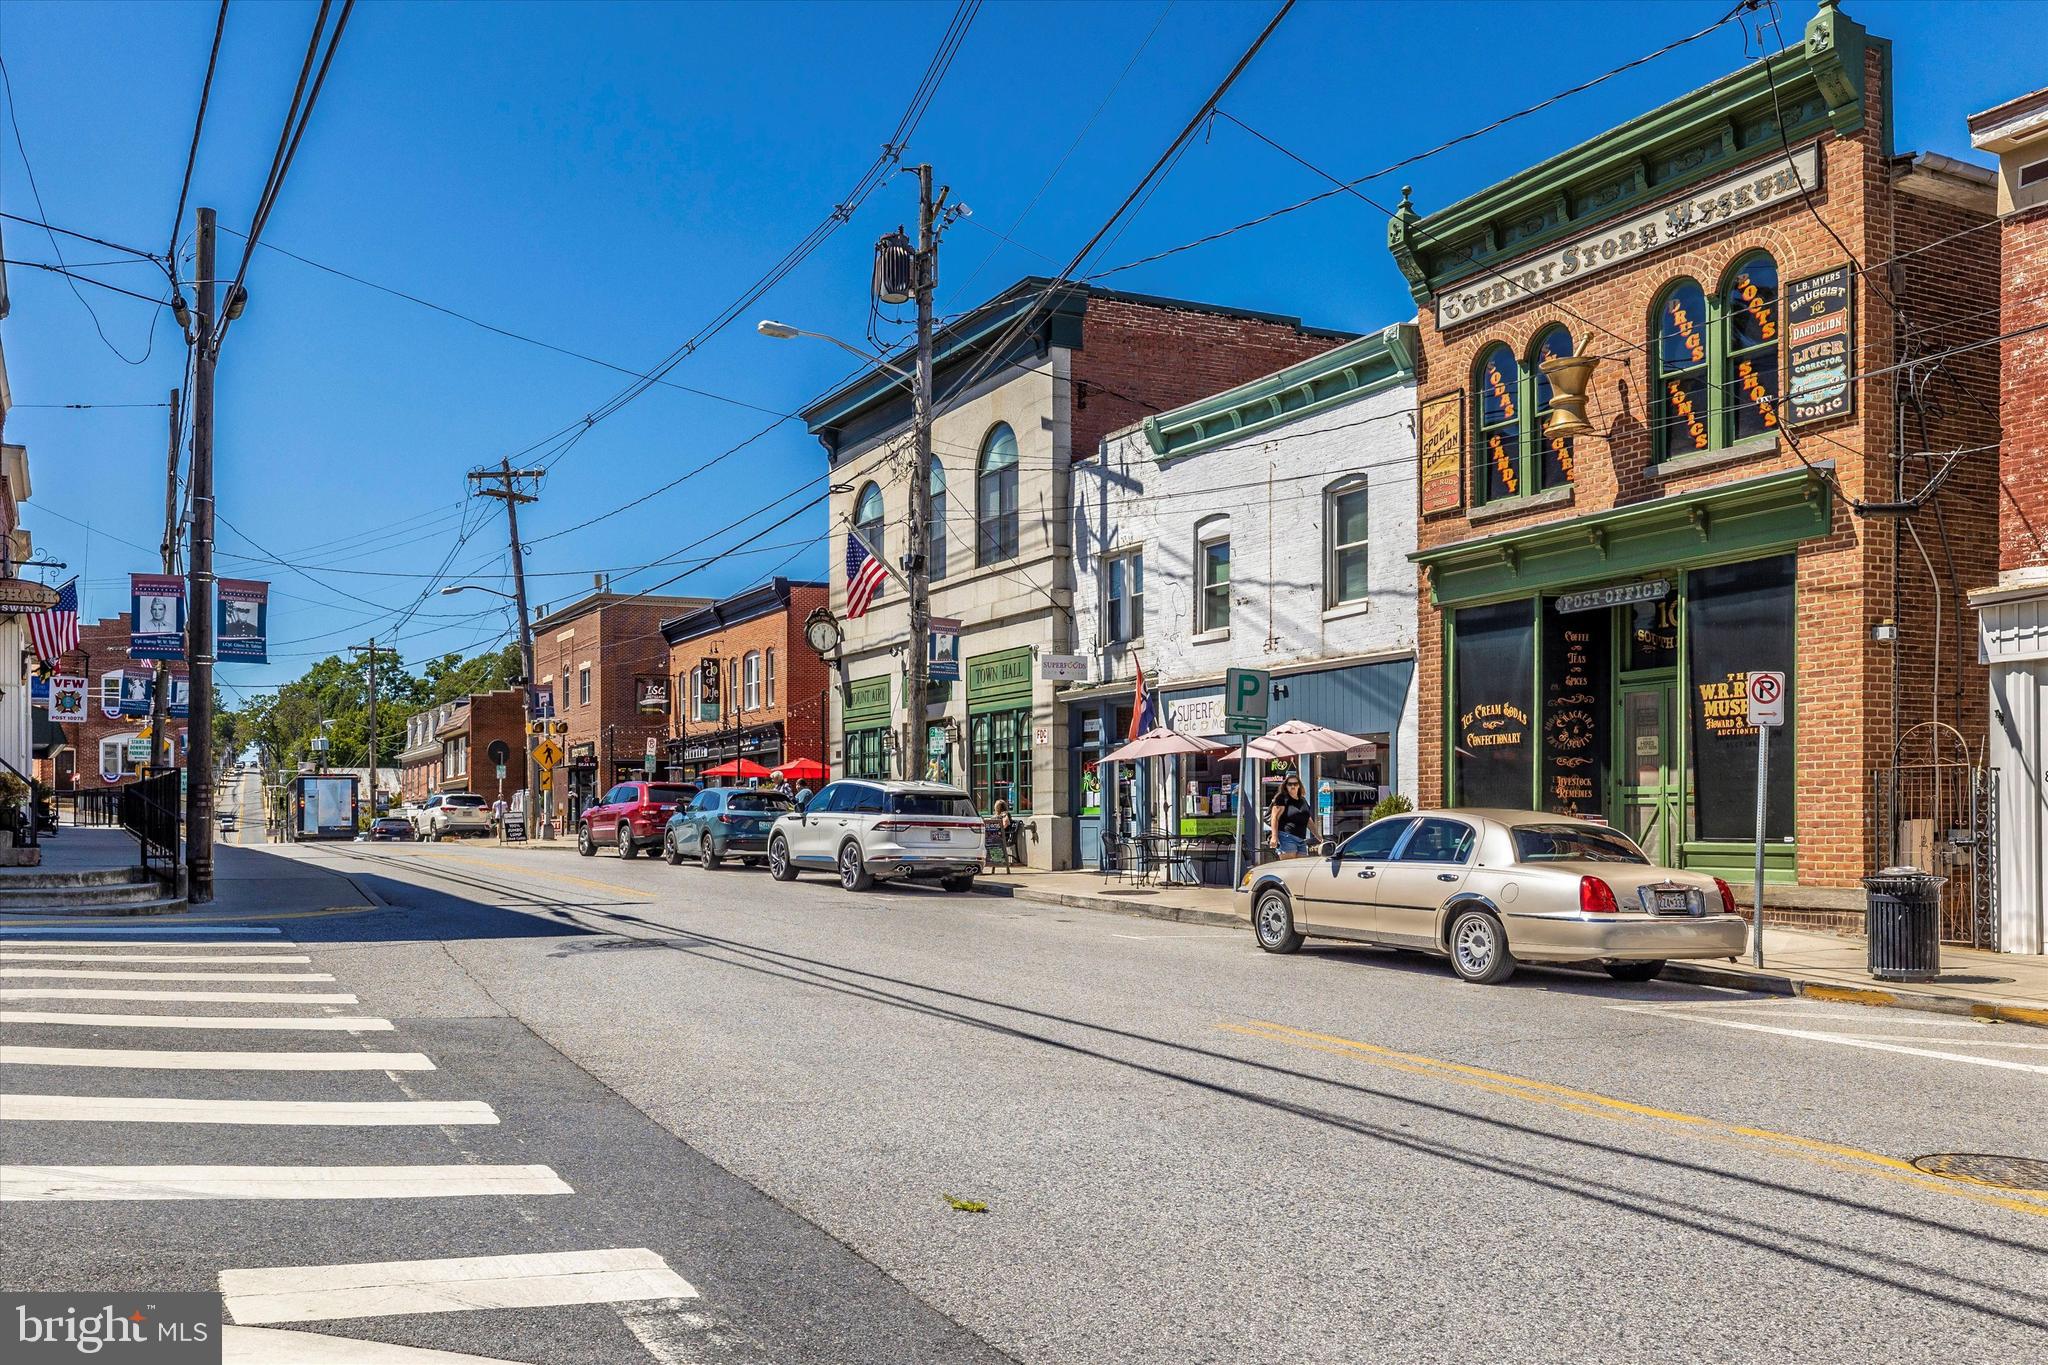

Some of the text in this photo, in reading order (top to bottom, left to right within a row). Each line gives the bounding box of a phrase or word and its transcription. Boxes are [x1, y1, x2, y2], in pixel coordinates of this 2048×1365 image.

[1442, 260, 1558, 320] COUNTRY
[1560, 222, 1659, 277] STORE
[1812, 271, 1841, 288] MYERS
[1736, 273, 1776, 340] BOOTS
[1789, 286, 1846, 312] DRUGGIST
[1668, 299, 1705, 362] DRUGS
[1793, 316, 1842, 341] DANDELION
[1791, 340, 1846, 366] LIVER
[1487, 360, 1515, 418] SODAS
[1667, 379, 1708, 449] TONICS
[1795, 396, 1843, 417] TONIC
[1423, 423, 1450, 456] SPOOL
[1426, 432, 1458, 469] COTTON
[1489, 435, 1517, 493] CANDY
[1605, 581, 1663, 603] OFFICE
[1564, 630, 1590, 642] COFFEE
[1637, 628, 1675, 649] SOUTH
[1043, 661, 1087, 670] SUPERFOODS
[1567, 652, 1586, 664] TEAS
[975, 661, 1023, 684] TOWN HALL
[1565, 675, 1588, 686] SPICES
[53, 679, 85, 689] VFW
[871, 687, 886, 701] AIRY
[1237, 674, 1260, 712] P
[1460, 701, 1528, 730] ICE CREAM SODAS
[1036, 728, 1047, 739] FDC
[1466, 732, 1521, 749] CONFECTIONARY
[1555, 786, 1593, 799] REMEDIES
[1556, 776, 1592, 788] LIVESTOCK
